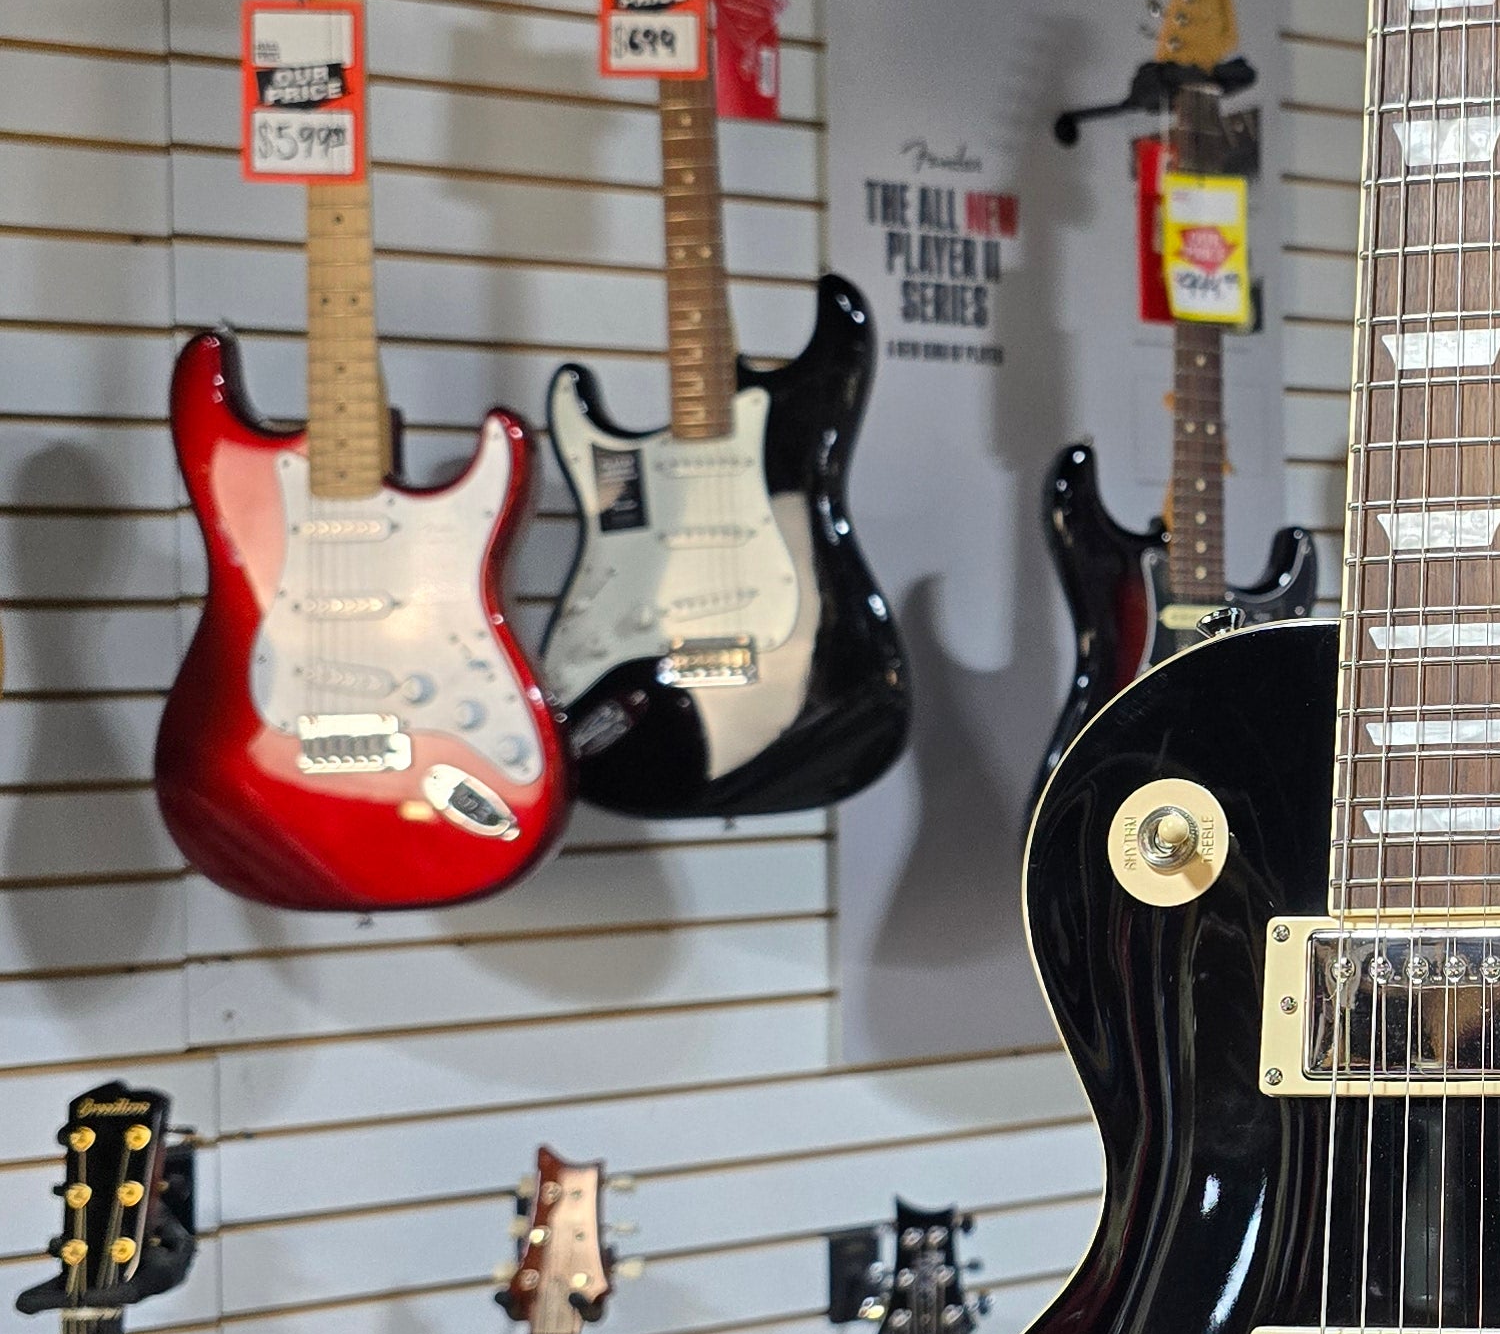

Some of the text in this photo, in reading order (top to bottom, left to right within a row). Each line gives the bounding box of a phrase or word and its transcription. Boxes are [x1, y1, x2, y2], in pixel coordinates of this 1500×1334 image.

[263, 82, 343, 107] PRICE
[272, 66, 330, 89] OUR
[864, 178, 908, 227] THE
[918, 185, 956, 233] ALL
[902, 280, 988, 328] SERIES
[1123, 816, 1138, 871] RHYTHM
[1201, 815, 1215, 864] TREBLE
